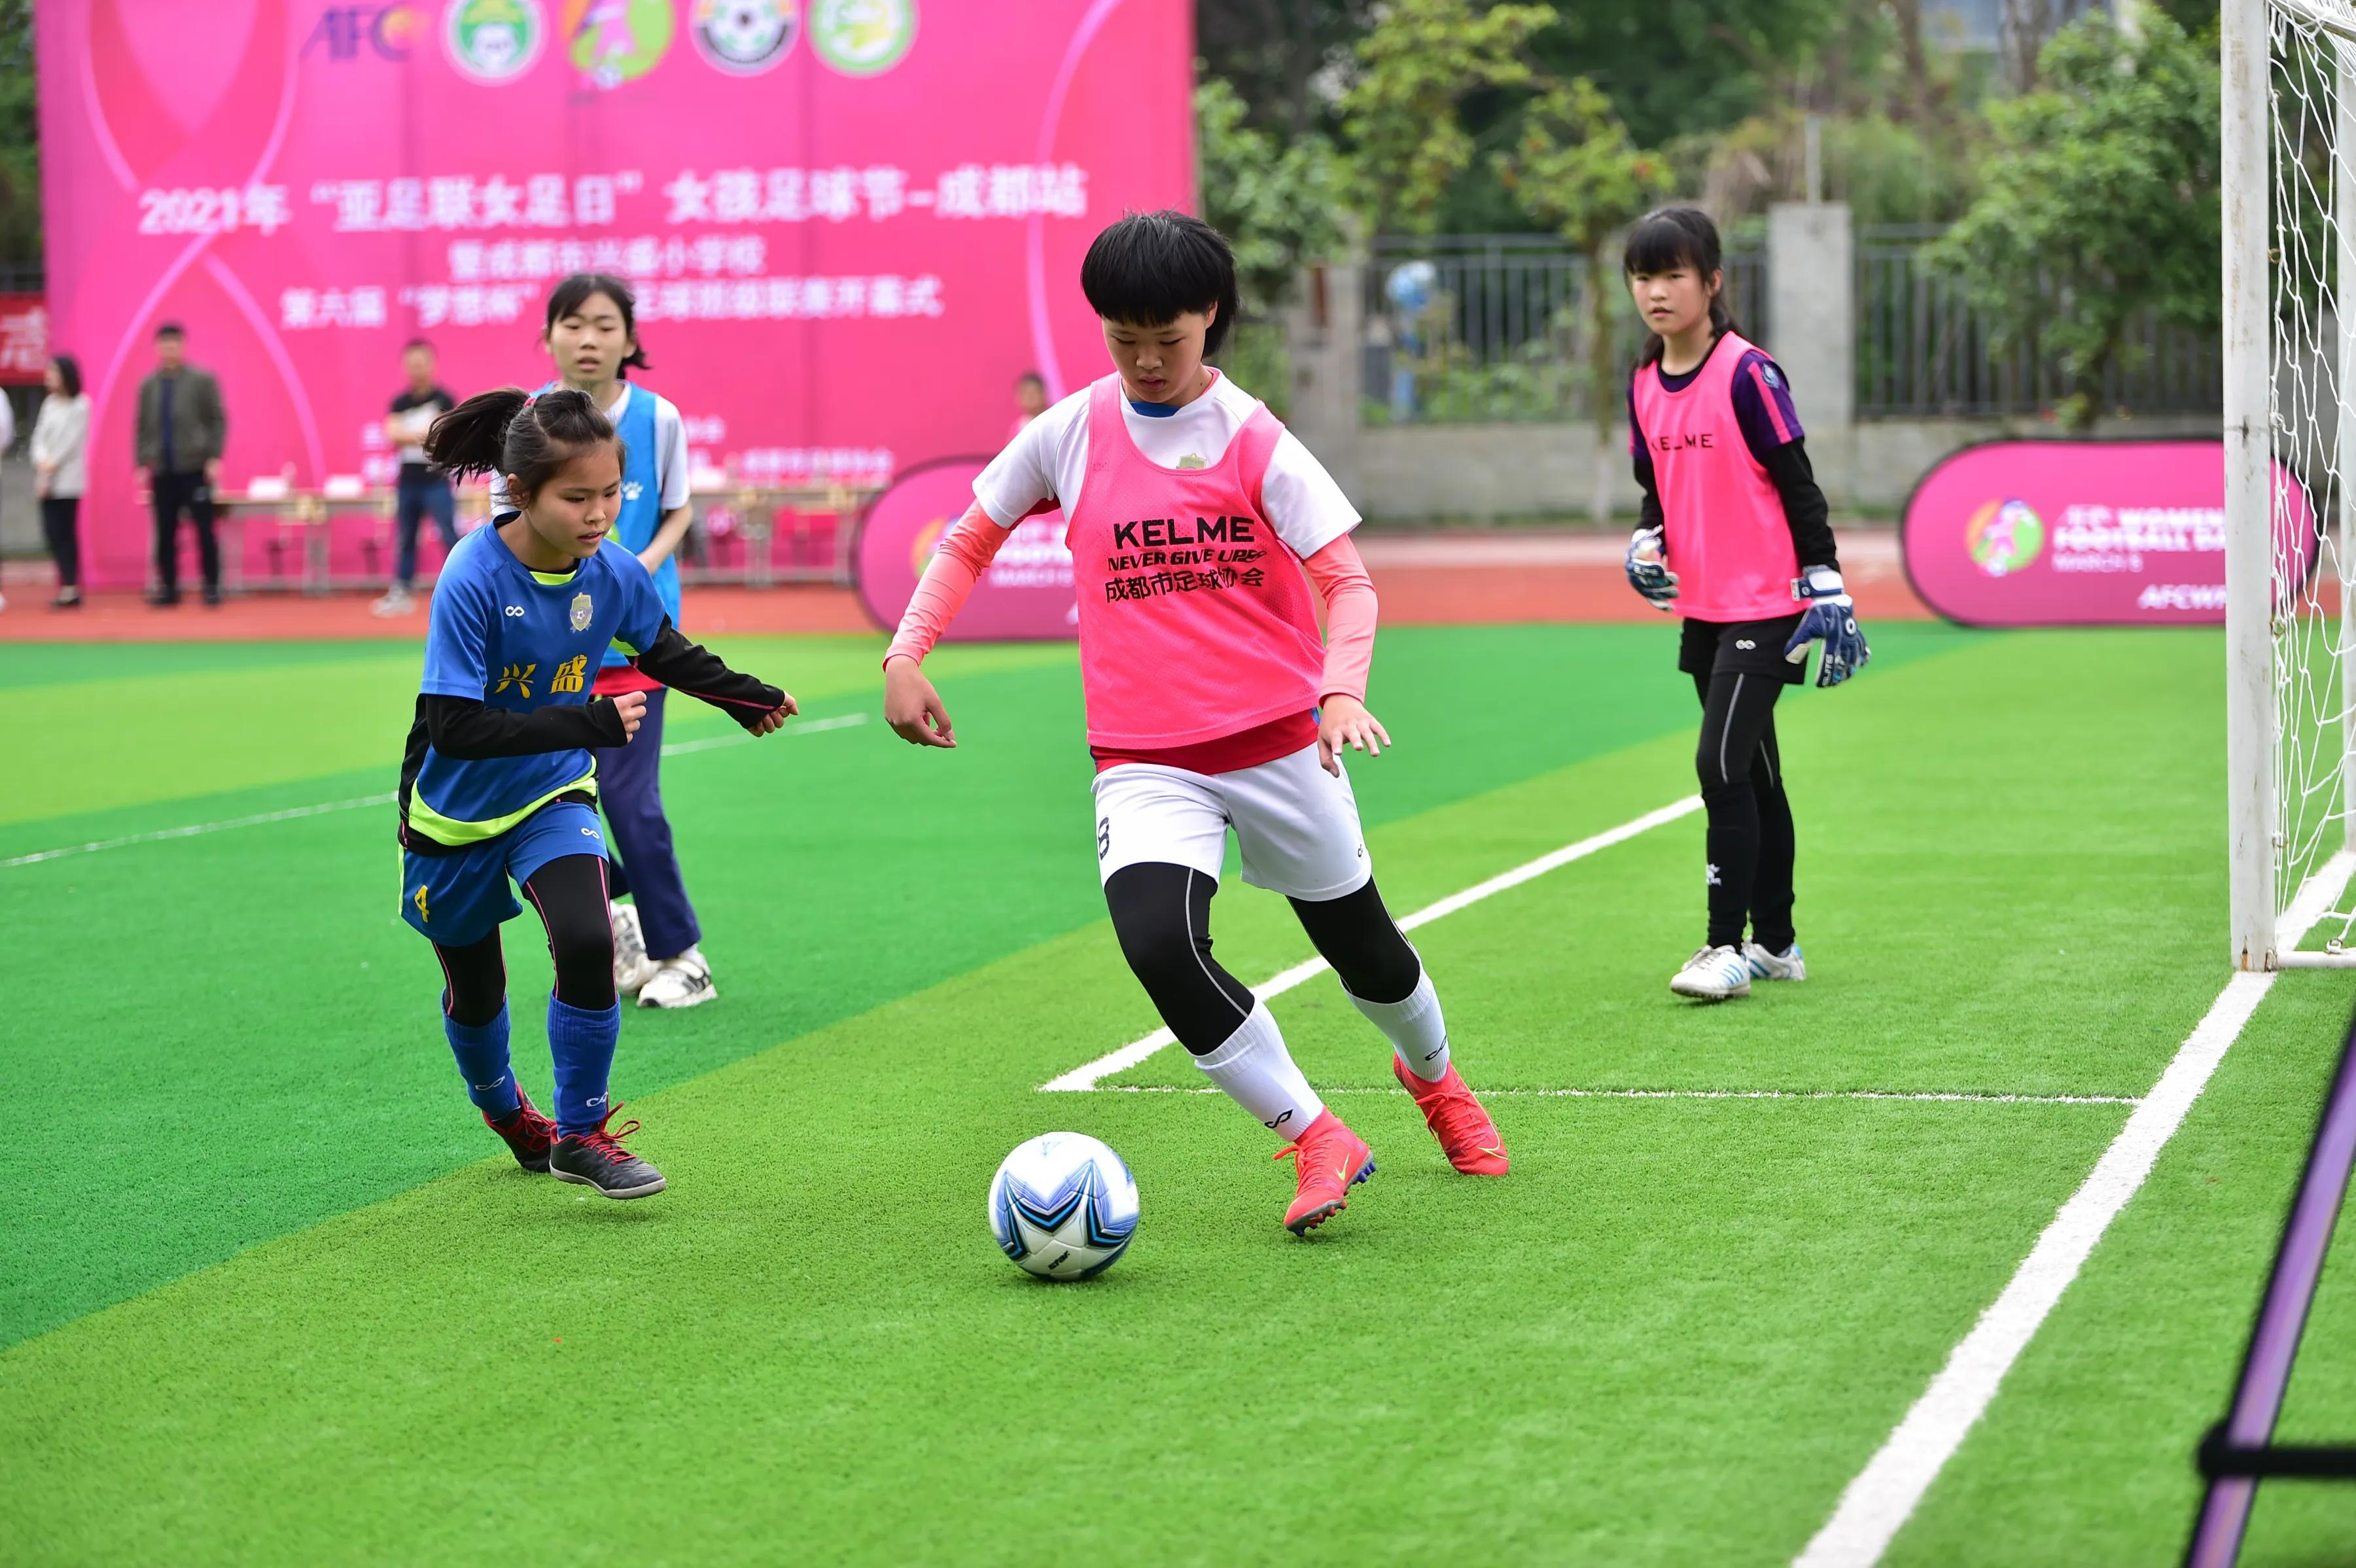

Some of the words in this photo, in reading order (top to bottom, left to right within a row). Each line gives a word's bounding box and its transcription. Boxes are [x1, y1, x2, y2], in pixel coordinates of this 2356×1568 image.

[301, 5, 410, 62] AFC
[138, 184, 290, 235] 2021年
[280, 287, 387, 329] 第六届
[1651, 434, 1714, 452] EME
[1113, 515, 1255, 550] KELME
[1108, 552, 1168, 571] NEVER
[1170, 549, 1215, 565] GIVE
[1104, 566, 1265, 604] 成都市足球协会
[493, 653, 588, 699] 兴盛
[413, 884, 430, 923] 4
